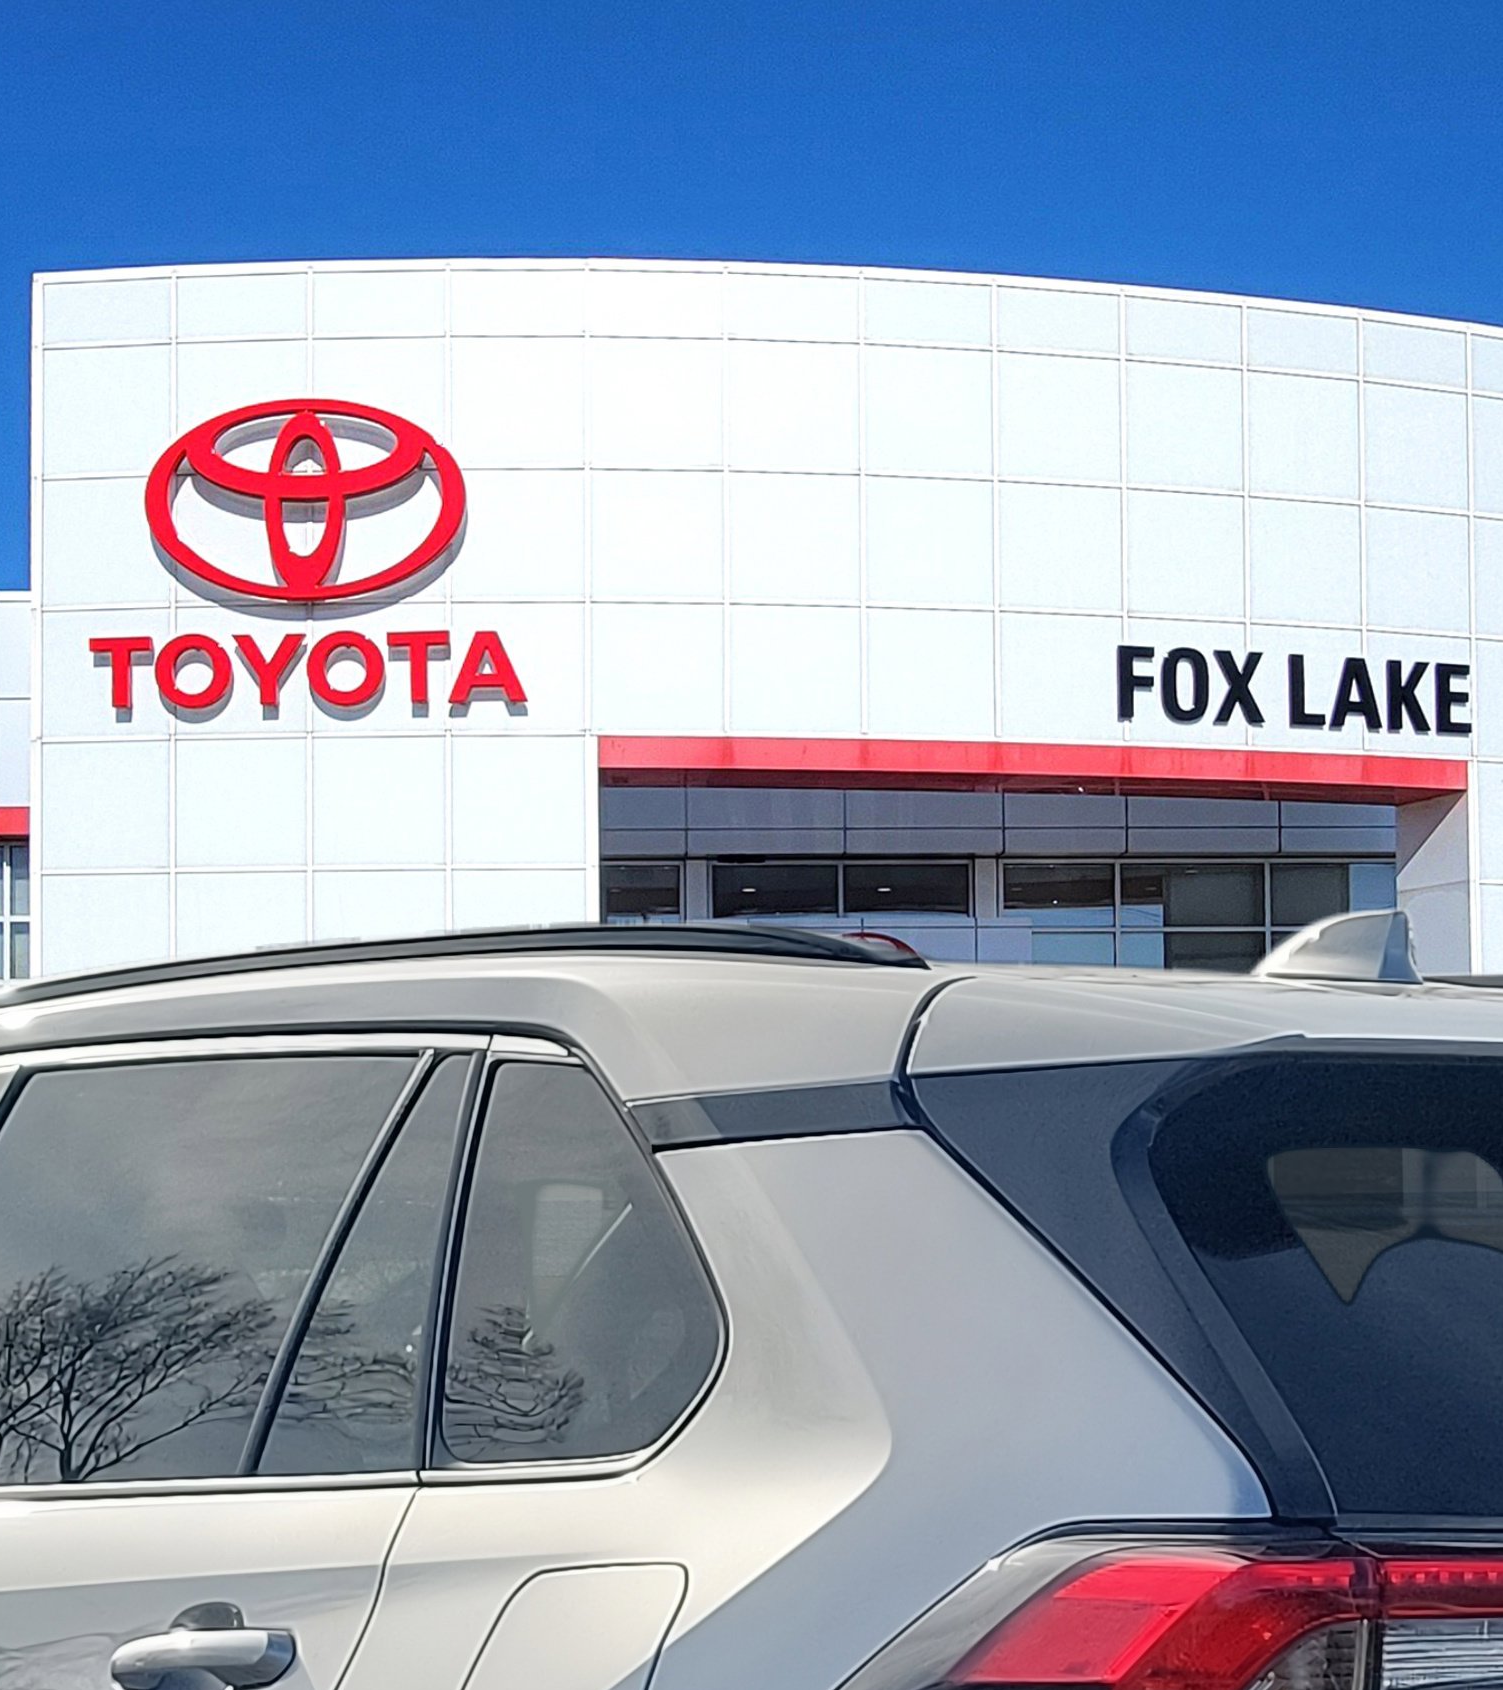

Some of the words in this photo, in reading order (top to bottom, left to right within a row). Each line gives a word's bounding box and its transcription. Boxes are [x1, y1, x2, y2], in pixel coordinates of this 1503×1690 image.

[89, 630, 528, 720] TOYOTA
[1116, 645, 1265, 728] FOX
[1288, 654, 1473, 736] LAKE
